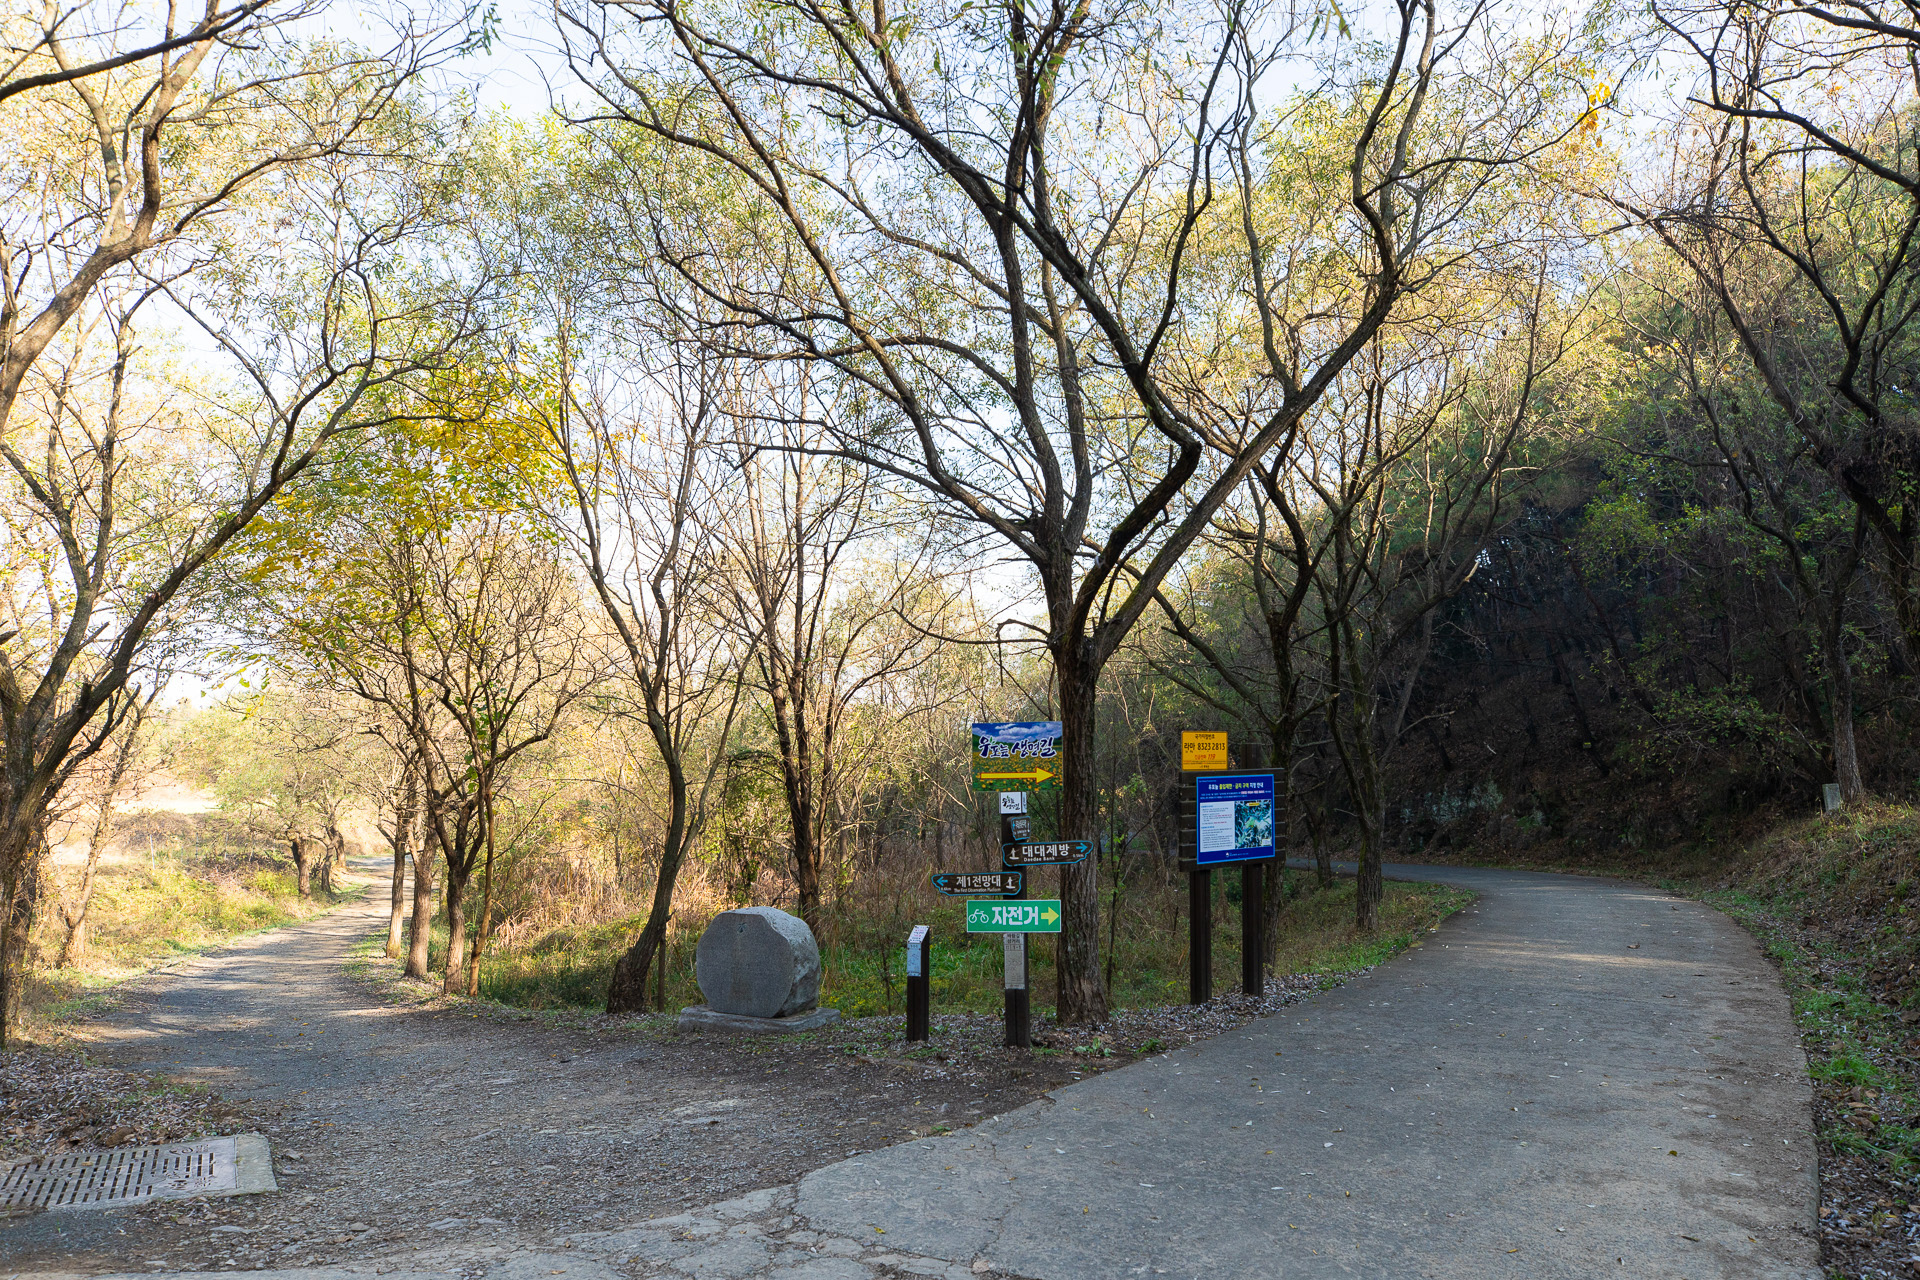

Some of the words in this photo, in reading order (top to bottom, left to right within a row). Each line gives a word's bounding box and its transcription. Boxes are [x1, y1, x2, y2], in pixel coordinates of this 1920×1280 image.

[1011, 735, 1057, 758] 생명길
[1197, 742, 1211, 751] 8323
[1212, 742, 1225, 751] 2813
[1022, 844, 1070, 857] 대대제방
[956, 874, 1001, 888] 제1전망대
[991, 906, 1038, 926] 자전거
